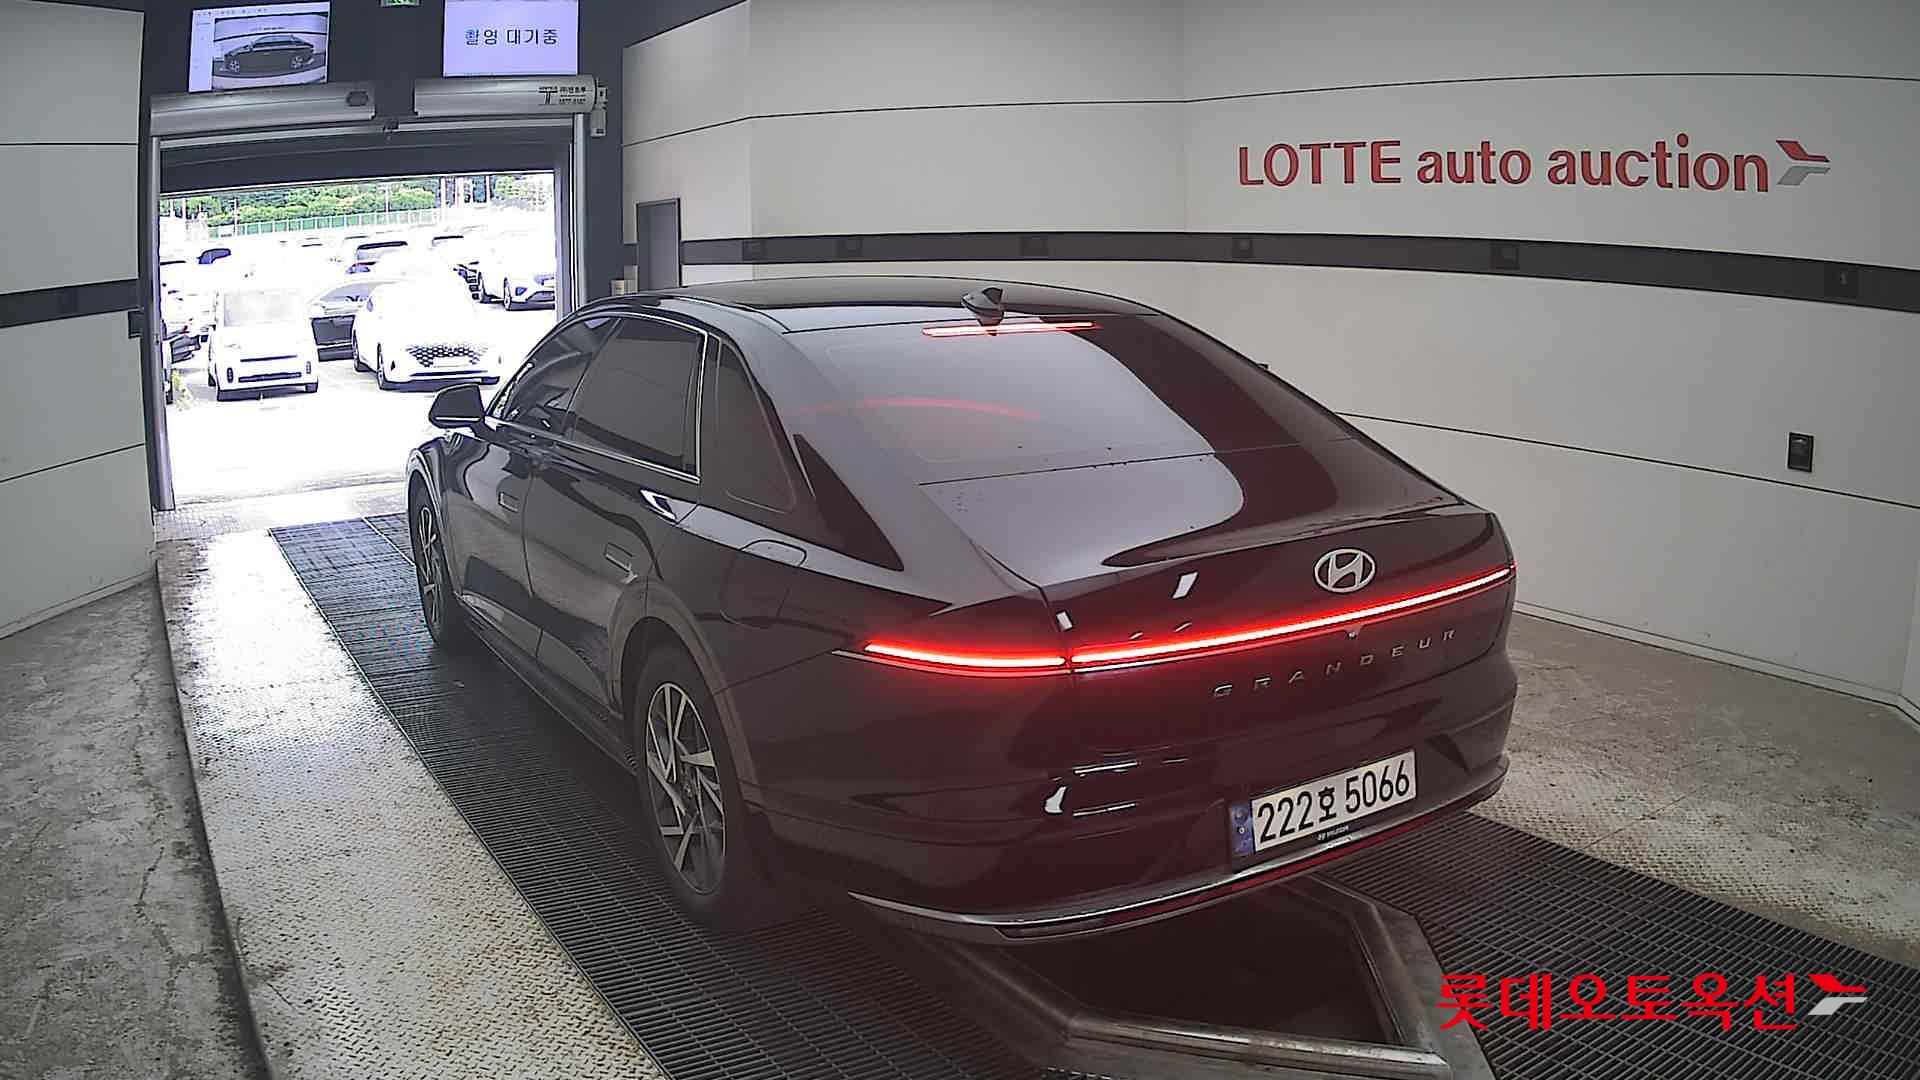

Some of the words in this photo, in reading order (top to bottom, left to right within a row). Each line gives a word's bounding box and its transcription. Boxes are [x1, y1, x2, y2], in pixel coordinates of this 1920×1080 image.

[505, 28, 559, 46] 대기중
[1238, 138, 1402, 187] LOTTE
[1416, 140, 1532, 185] auto
[1547, 132, 1769, 193] auction
[1213, 628, 1456, 697] GRANDEUR
[1257, 786, 1337, 844] 222호
[1345, 759, 1410, 813] 5066
